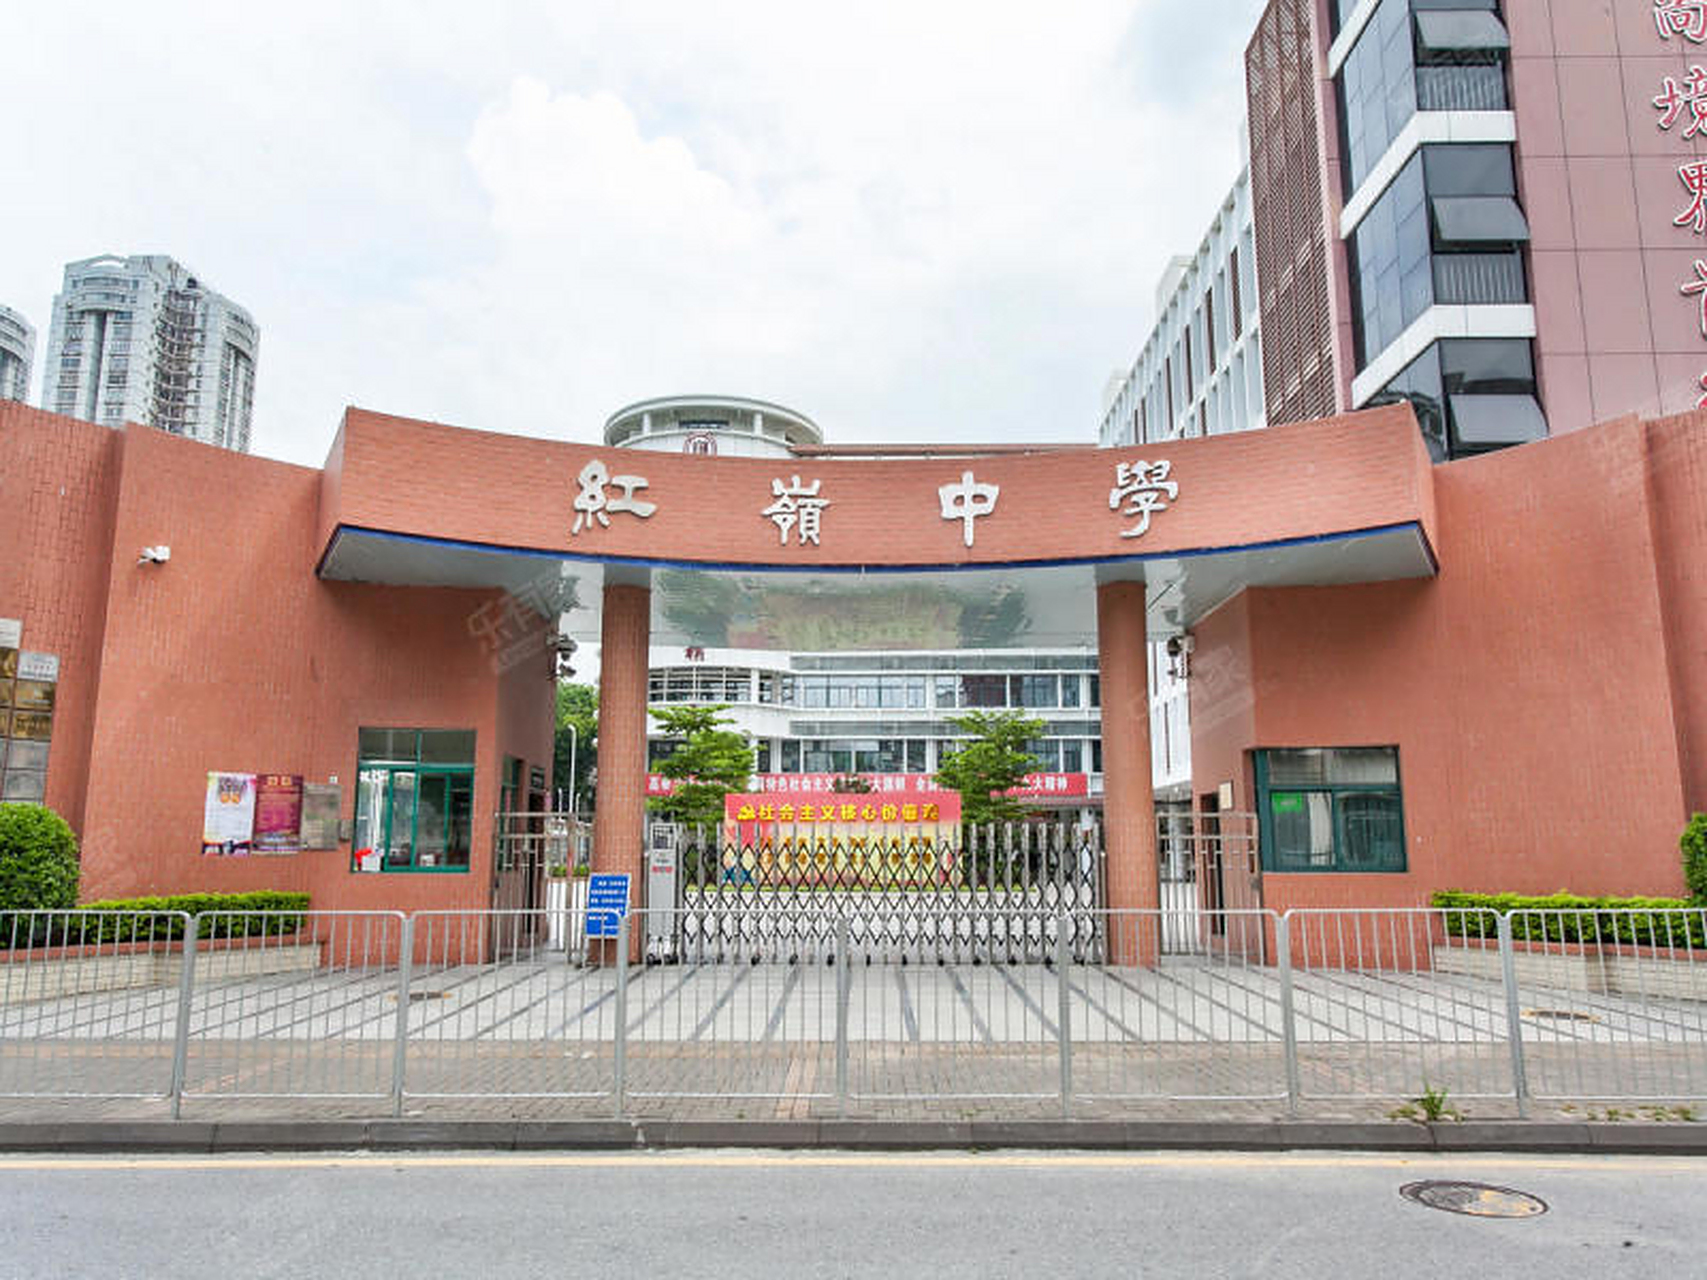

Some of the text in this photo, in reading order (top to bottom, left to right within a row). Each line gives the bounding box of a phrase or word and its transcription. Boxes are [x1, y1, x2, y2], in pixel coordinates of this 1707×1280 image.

[572, 459, 1179, 547] 紅嶺中學
[757, 803, 940, 822] 社会主义核心价值观
